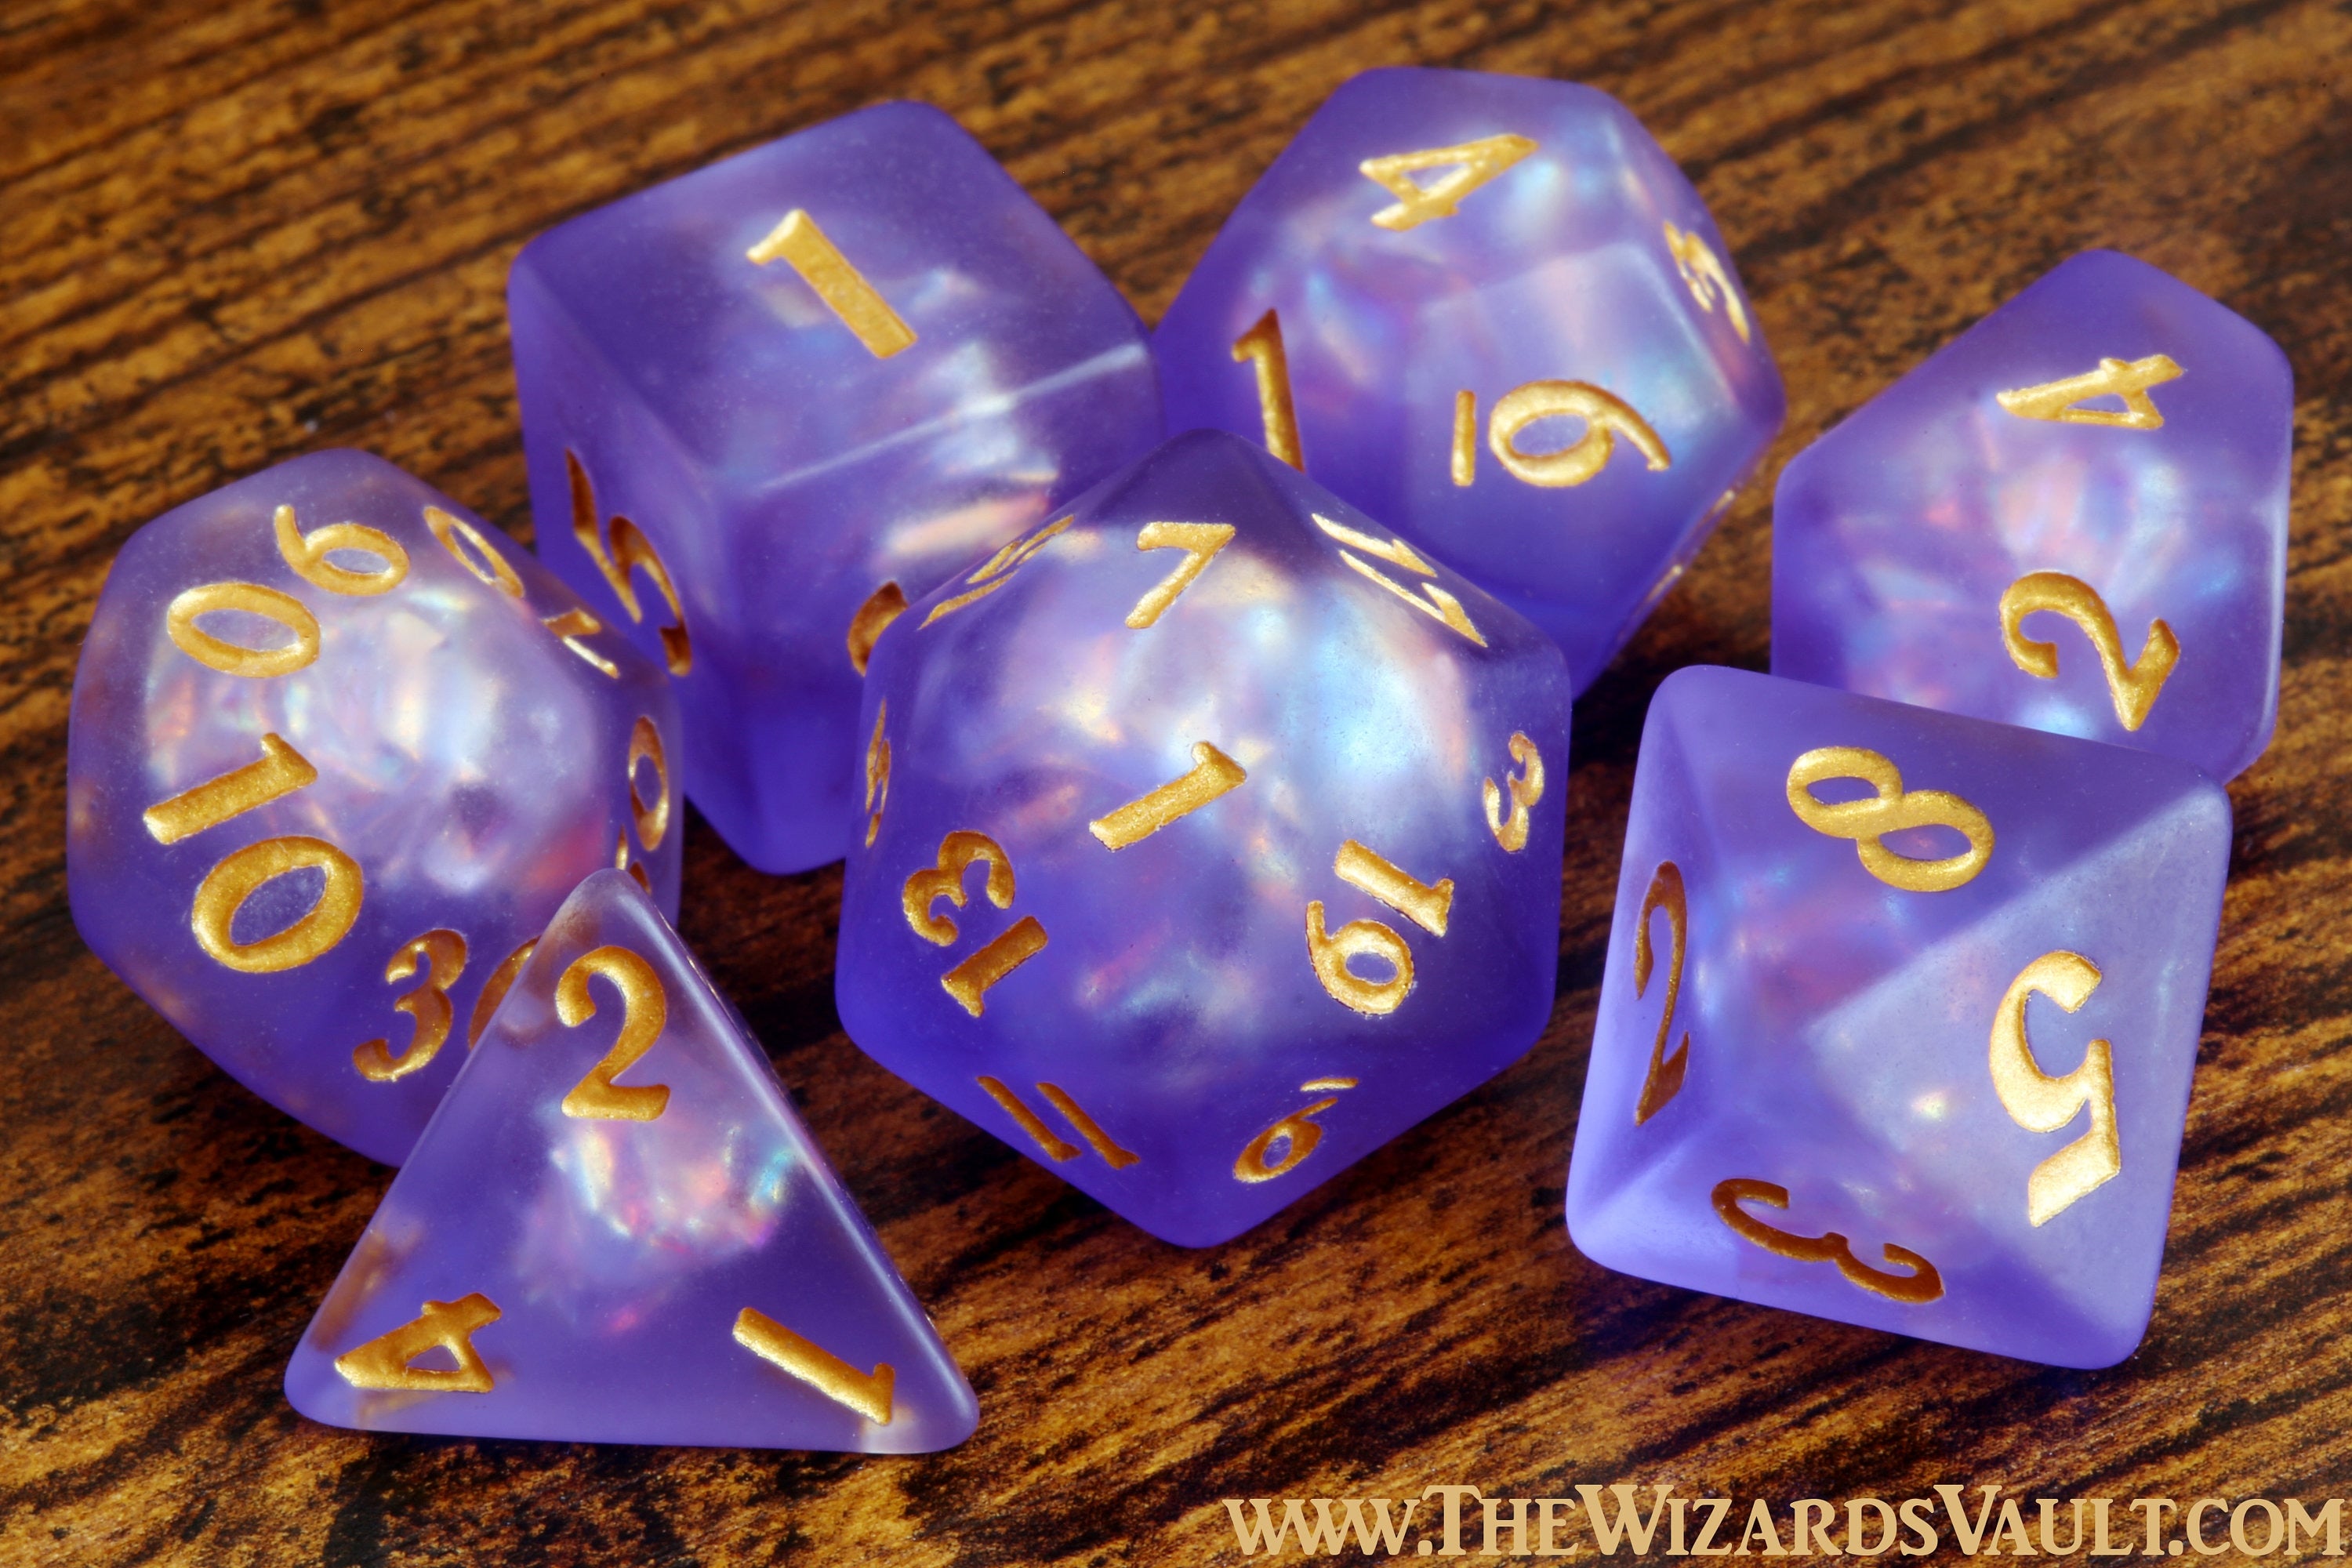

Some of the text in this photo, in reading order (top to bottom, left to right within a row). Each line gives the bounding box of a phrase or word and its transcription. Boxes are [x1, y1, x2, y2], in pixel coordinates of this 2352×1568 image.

[1359, 132, 1540, 231] 4
[746, 209, 918, 359] 1
[1232, 308, 1305, 472] 1
[1996, 354, 2186, 430] 4
[564, 446, 691, 677] 5
[1125, 521, 1236, 630] 7
[1999, 570, 2181, 731] 2
[143, 732, 363, 974] 10
[615, 716, 670, 895] 0
[1089, 740, 1247, 851] 1
[1483, 730, 1545, 853] 3
[1787, 745, 1996, 892] 8
[902, 829, 1049, 1018] 13
[1634, 861, 1690, 1127] 2
[554, 945, 672, 1123] 2
[1988, 949, 2122, 1228] 5
[1710, 1177, 1947, 1305] 3
[334, 1292, 503, 1393] 4
[731, 1307, 897, 1427] 1
